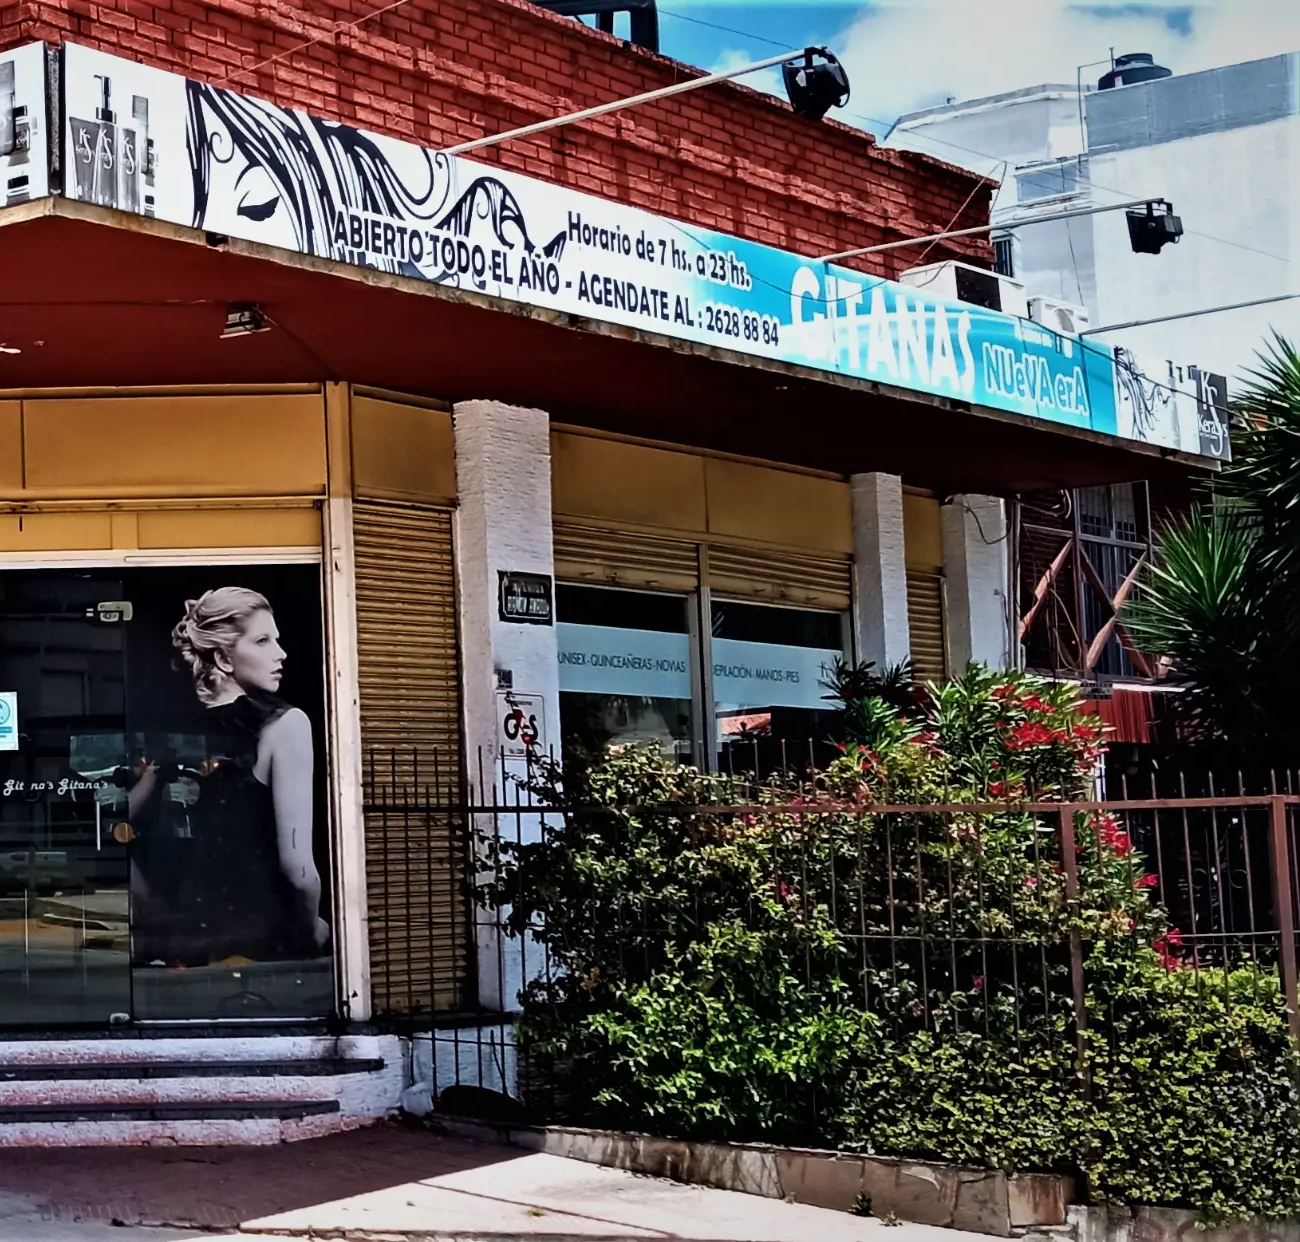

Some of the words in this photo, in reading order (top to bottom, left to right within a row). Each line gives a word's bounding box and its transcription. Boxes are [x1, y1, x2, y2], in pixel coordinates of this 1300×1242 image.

[334, 211, 424, 263] ABIERTO
[429, 234, 485, 278] TODO
[491, 249, 513, 285] EL
[518, 252, 560, 295] AÑO
[578, 270, 669, 321] AGENDATE
[674, 294, 694, 327] AL
[706, 305, 739, 338] 2628
[743, 314, 759, 342] 88
[763, 319, 779, 347] 84
[568, 211, 631, 256] Horario
[636, 230, 655, 262] de
[658, 239, 667, 266] 7
[671, 239, 692, 272] hs.
[696, 254, 706, 276] a
[710, 252, 726, 281] 23
[730, 254, 750, 288] hs.
[790, 266, 975, 395] GITANAS
